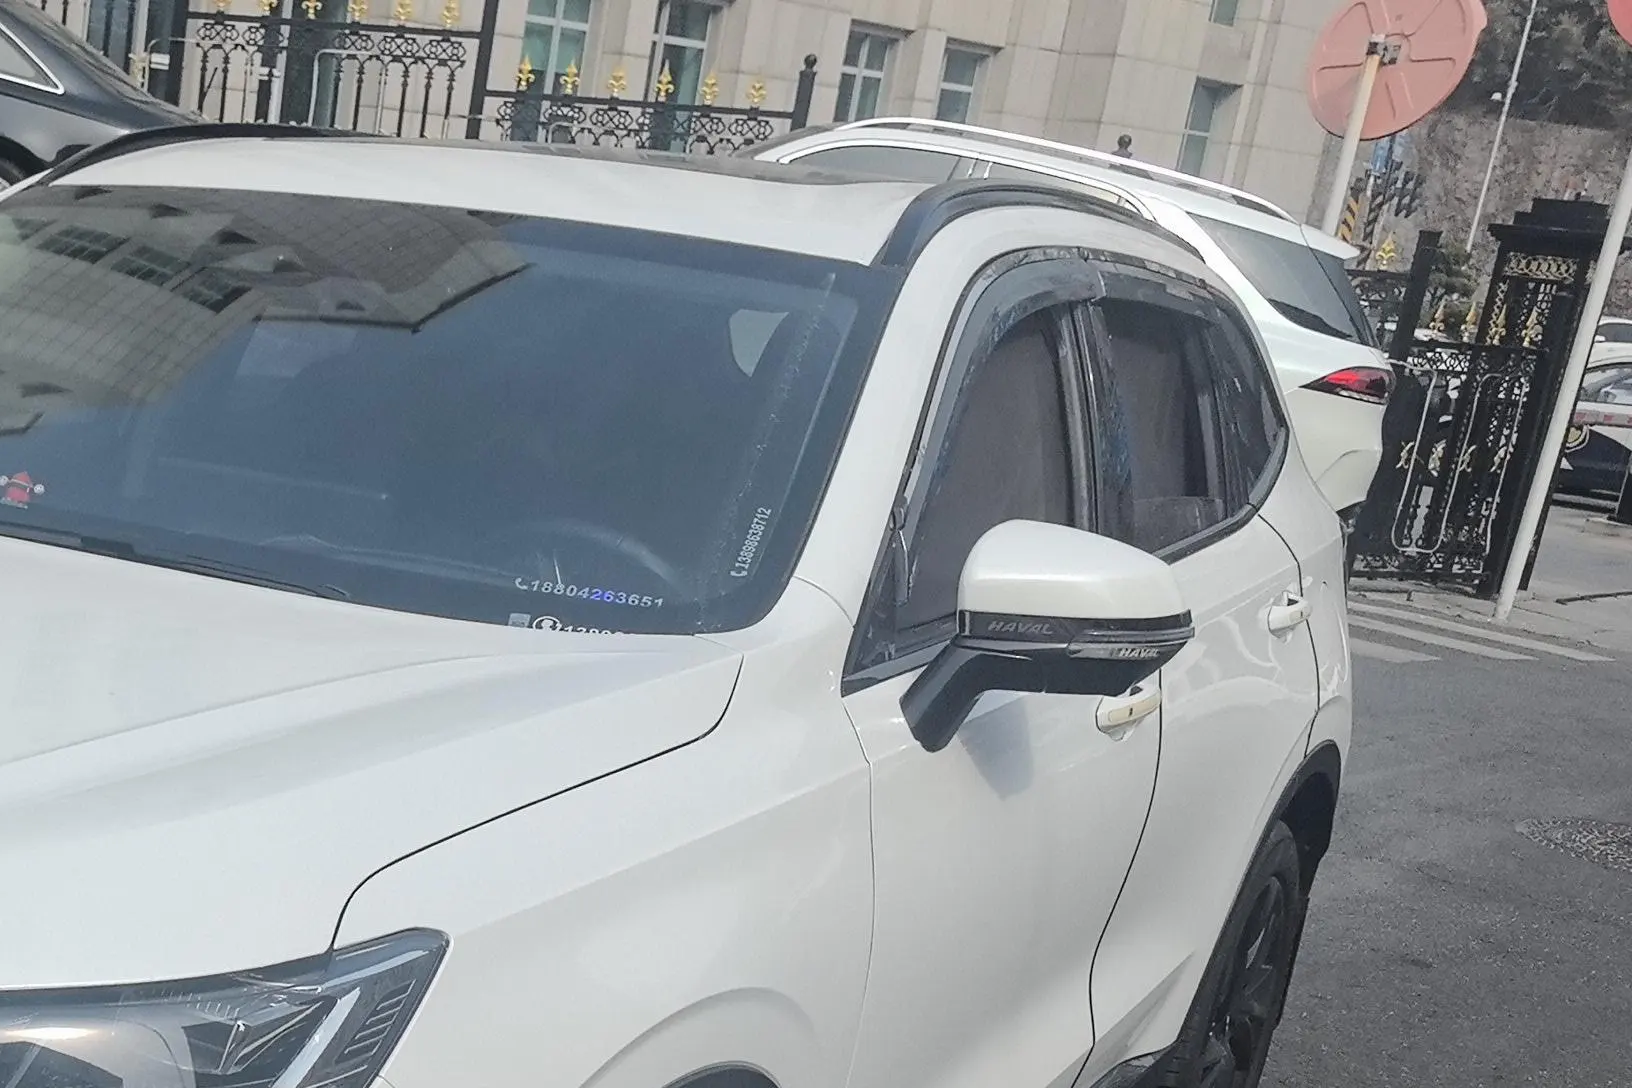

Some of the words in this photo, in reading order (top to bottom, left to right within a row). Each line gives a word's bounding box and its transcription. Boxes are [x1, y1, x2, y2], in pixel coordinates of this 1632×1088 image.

[735, 507, 772, 569] 13898638712
[531, 579, 664, 608] 18804263651
[987, 620, 1054, 635] HAVAL
